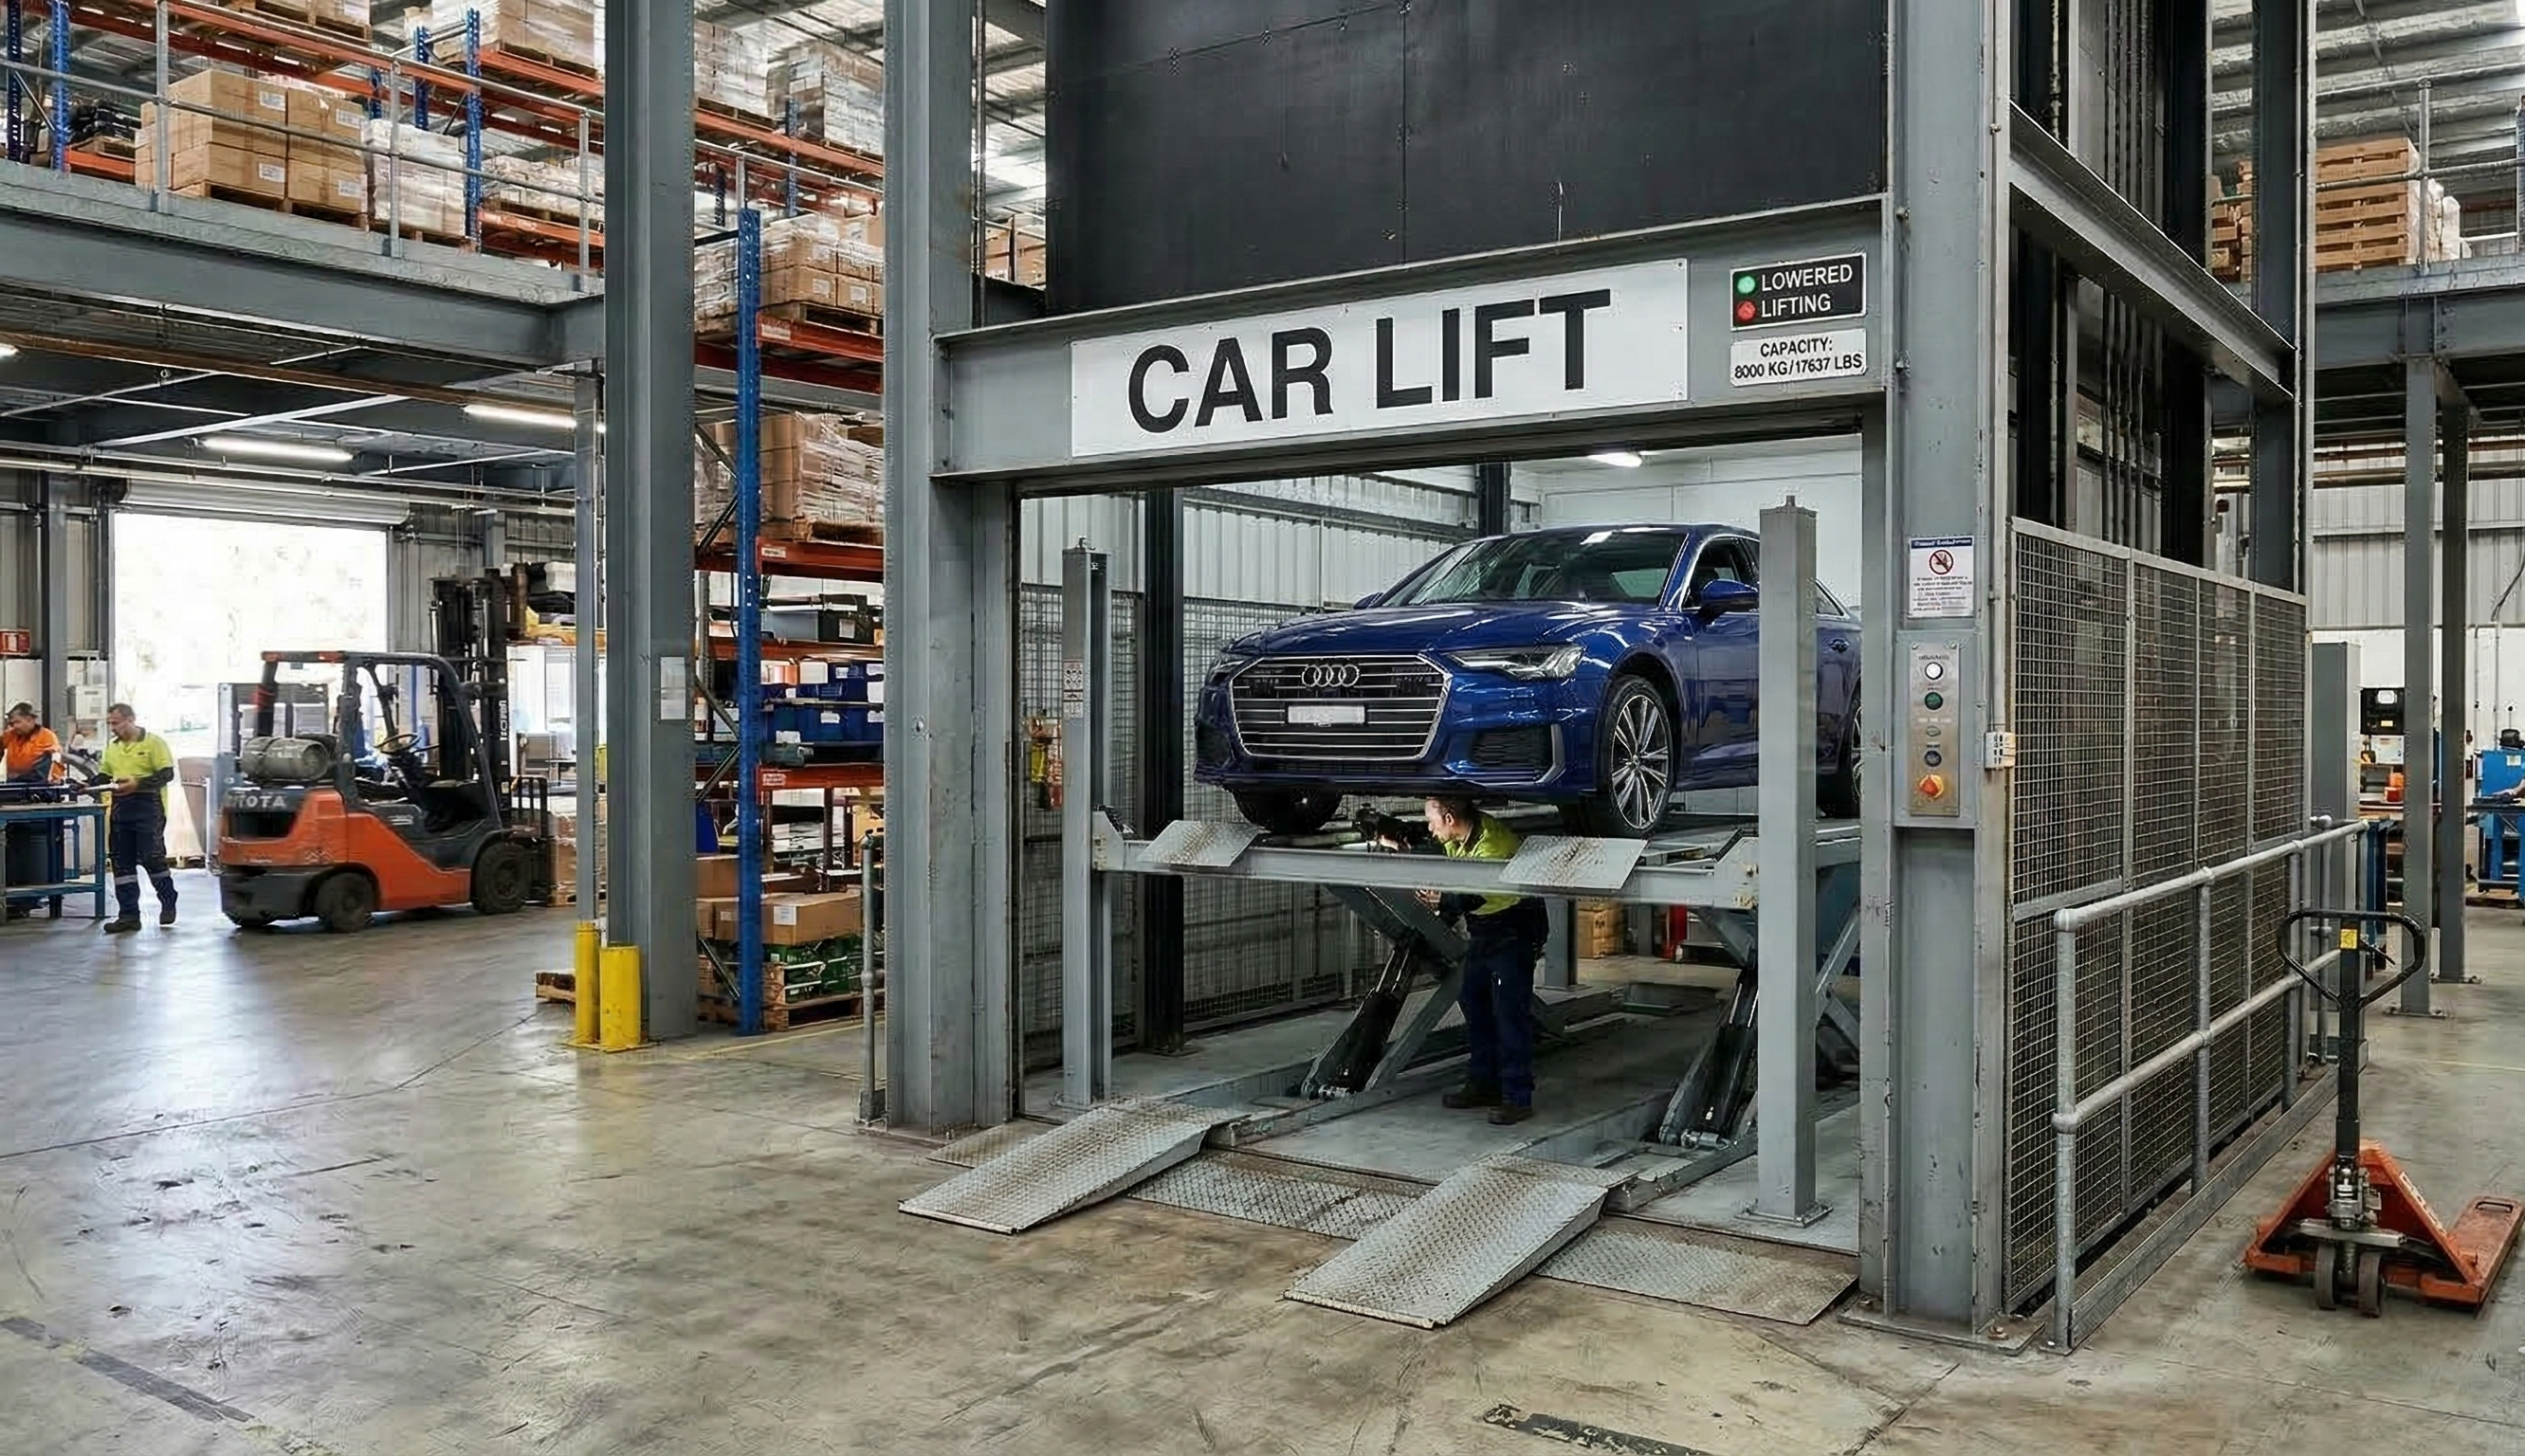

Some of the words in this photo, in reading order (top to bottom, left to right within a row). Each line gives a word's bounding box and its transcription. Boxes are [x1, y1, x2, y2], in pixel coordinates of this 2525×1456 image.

[1762, 264, 1853, 291] LOWERED
[1762, 293, 1831, 318] LIFTING
[1760, 337, 1833, 357] CAPACITY:
[1128, 327, 1333, 433] CAR
[1376, 289, 1610, 409] LIFT
[1734, 363, 1765, 379] 8000
[1835, 354, 1862, 371] LBS
